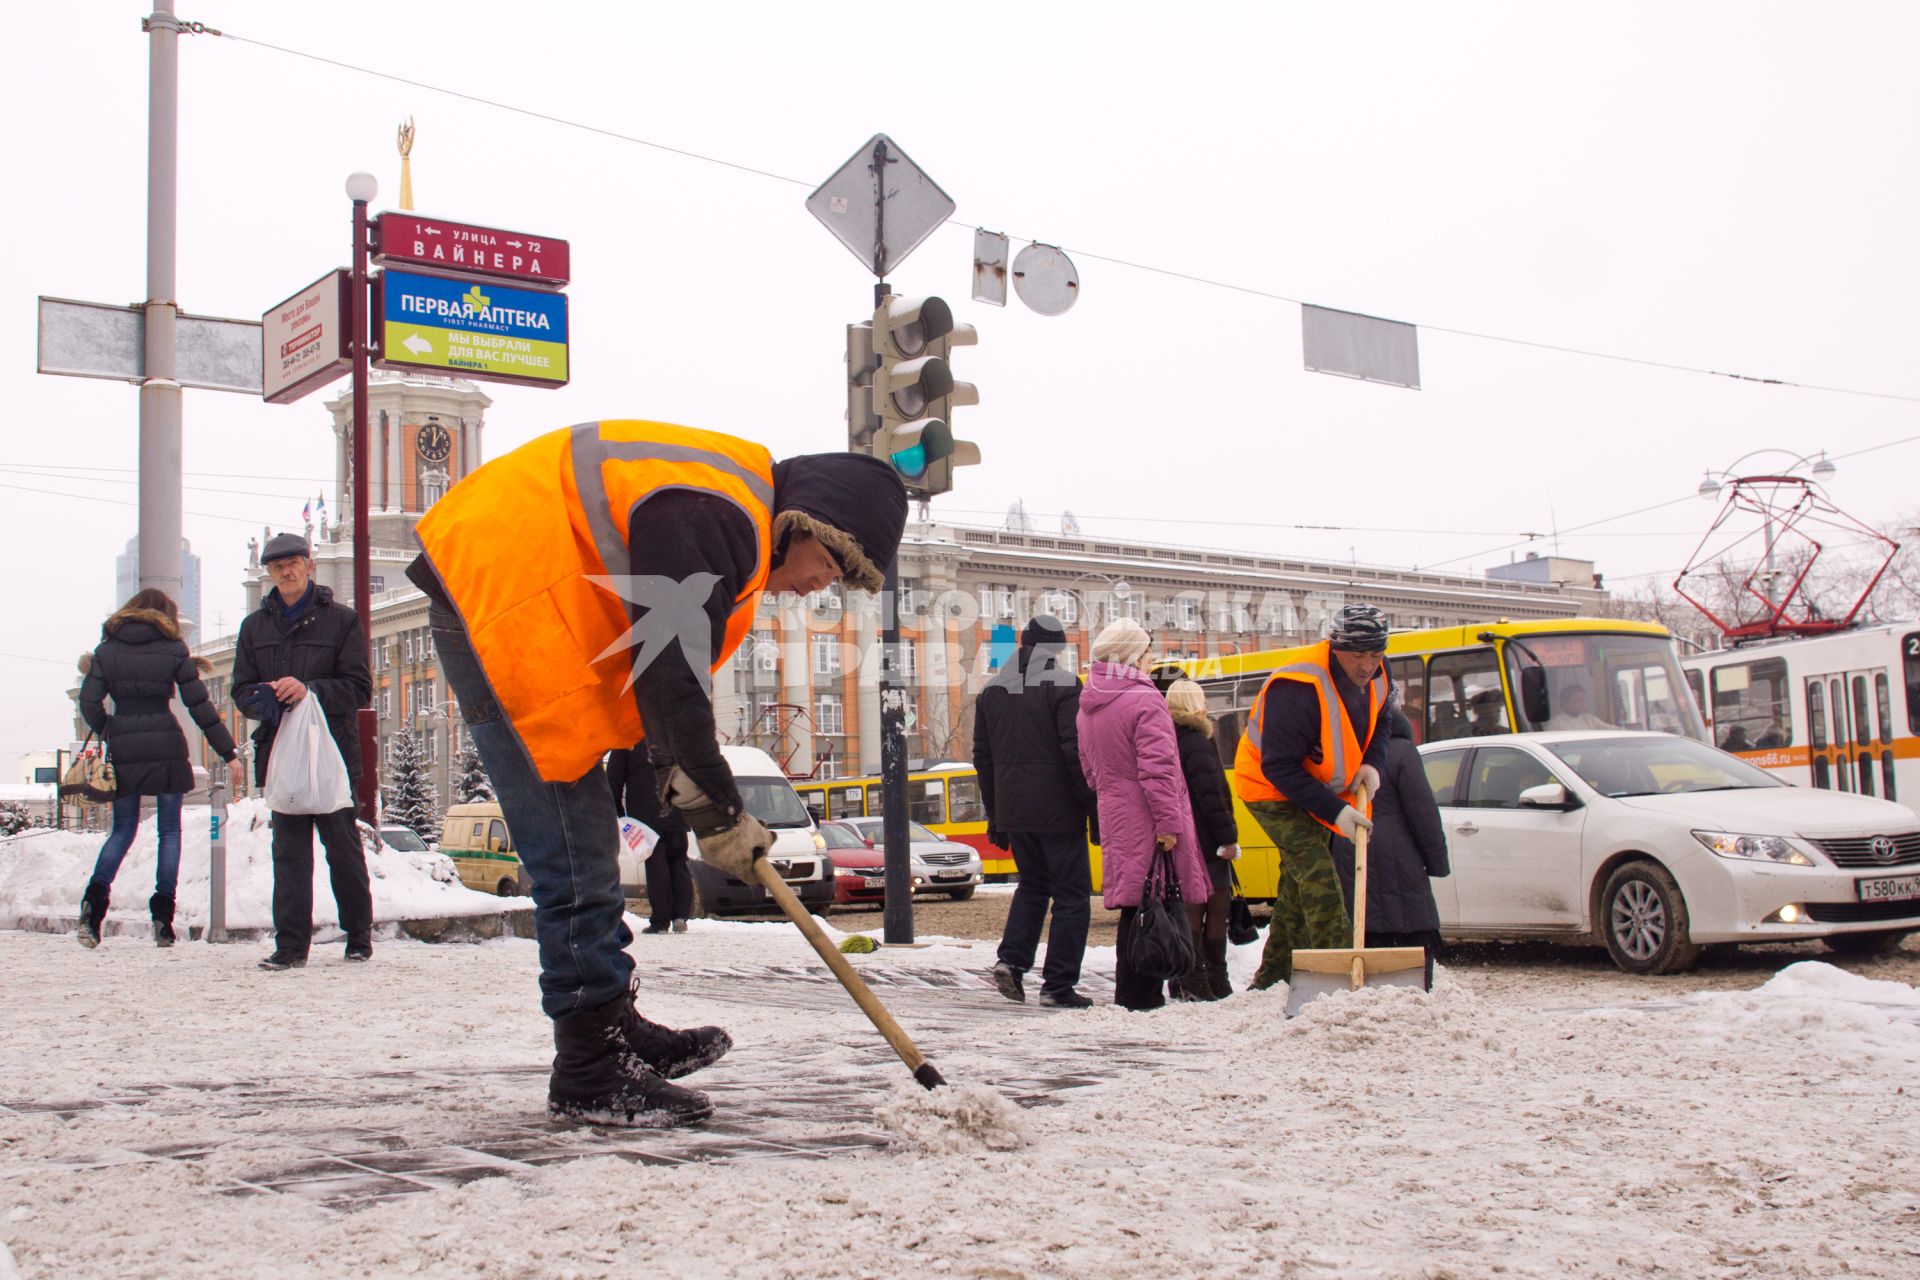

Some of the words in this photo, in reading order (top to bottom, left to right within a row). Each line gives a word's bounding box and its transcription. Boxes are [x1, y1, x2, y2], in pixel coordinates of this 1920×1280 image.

[415, 224, 421, 235] 1
[453, 230, 497, 246] УЛИЦА
[527, 241, 542, 253] 72
[413, 241, 542, 274] ВАЙНЕРА
[401, 294, 474, 320] ПЕРВАЯ
[478, 305, 550, 330] АПТЕКА
[443, 318, 465, 326] FIRST
[468, 320, 510, 332] PHARMACY
[448, 333, 470, 345] МЫ
[472, 335, 531, 353] ВЫБРАЛИ
[448, 345, 473, 359] ДЛЯ
[475, 349, 500, 362] ВАС
[501, 352, 550, 368] ЛУЧШЕЕ
[448, 358, 483, 369] ВАЙНЕРА
[484, 362, 488, 370] 1
